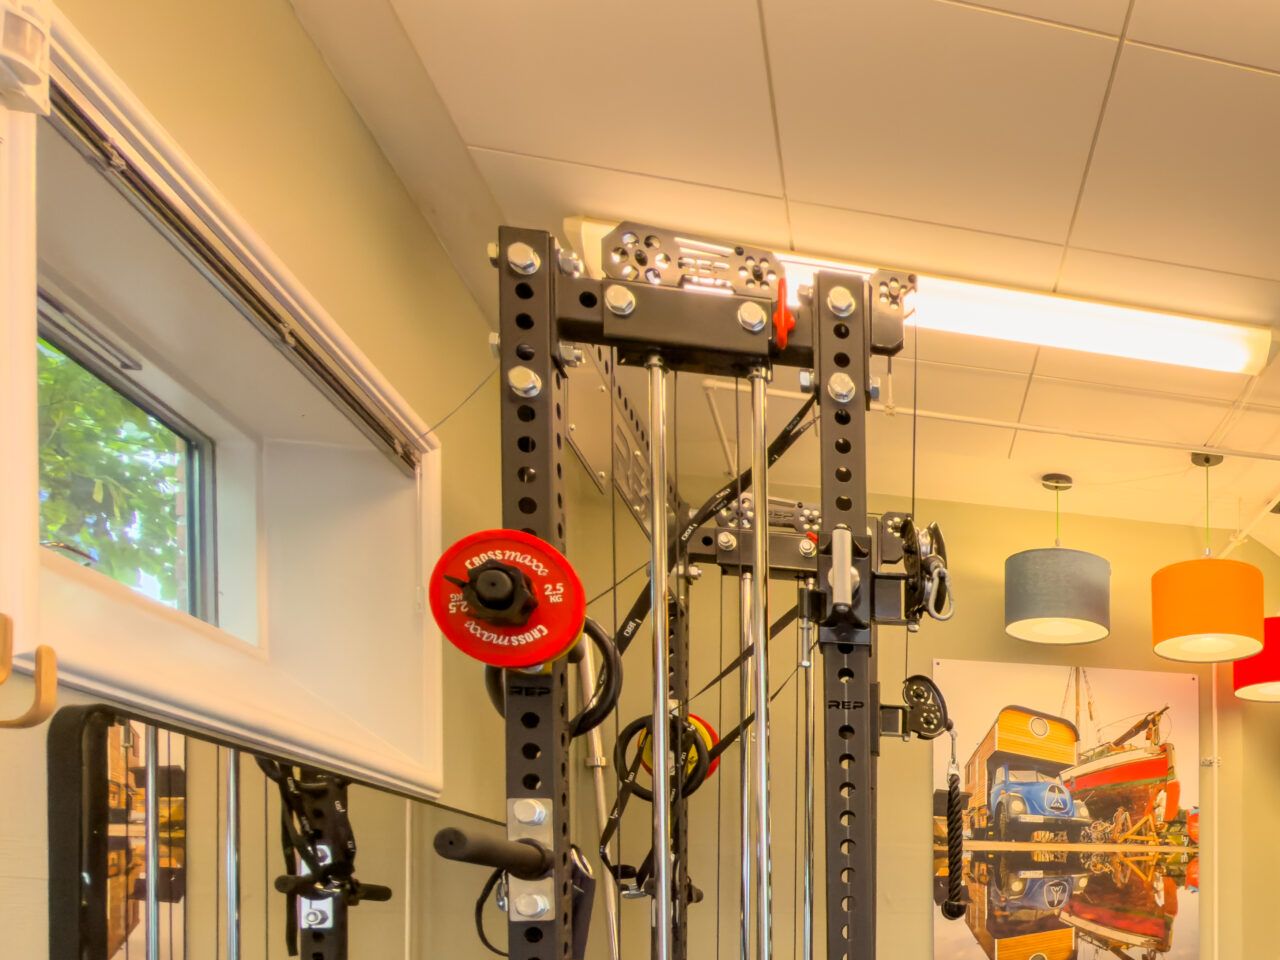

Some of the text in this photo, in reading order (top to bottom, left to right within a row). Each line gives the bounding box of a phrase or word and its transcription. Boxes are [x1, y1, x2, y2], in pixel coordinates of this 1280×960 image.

[544, 583, 564, 595] 2.5
[550, 595, 563, 603] KG
[449, 601, 469, 613] 2.5
[828, 700, 865, 710] REP
